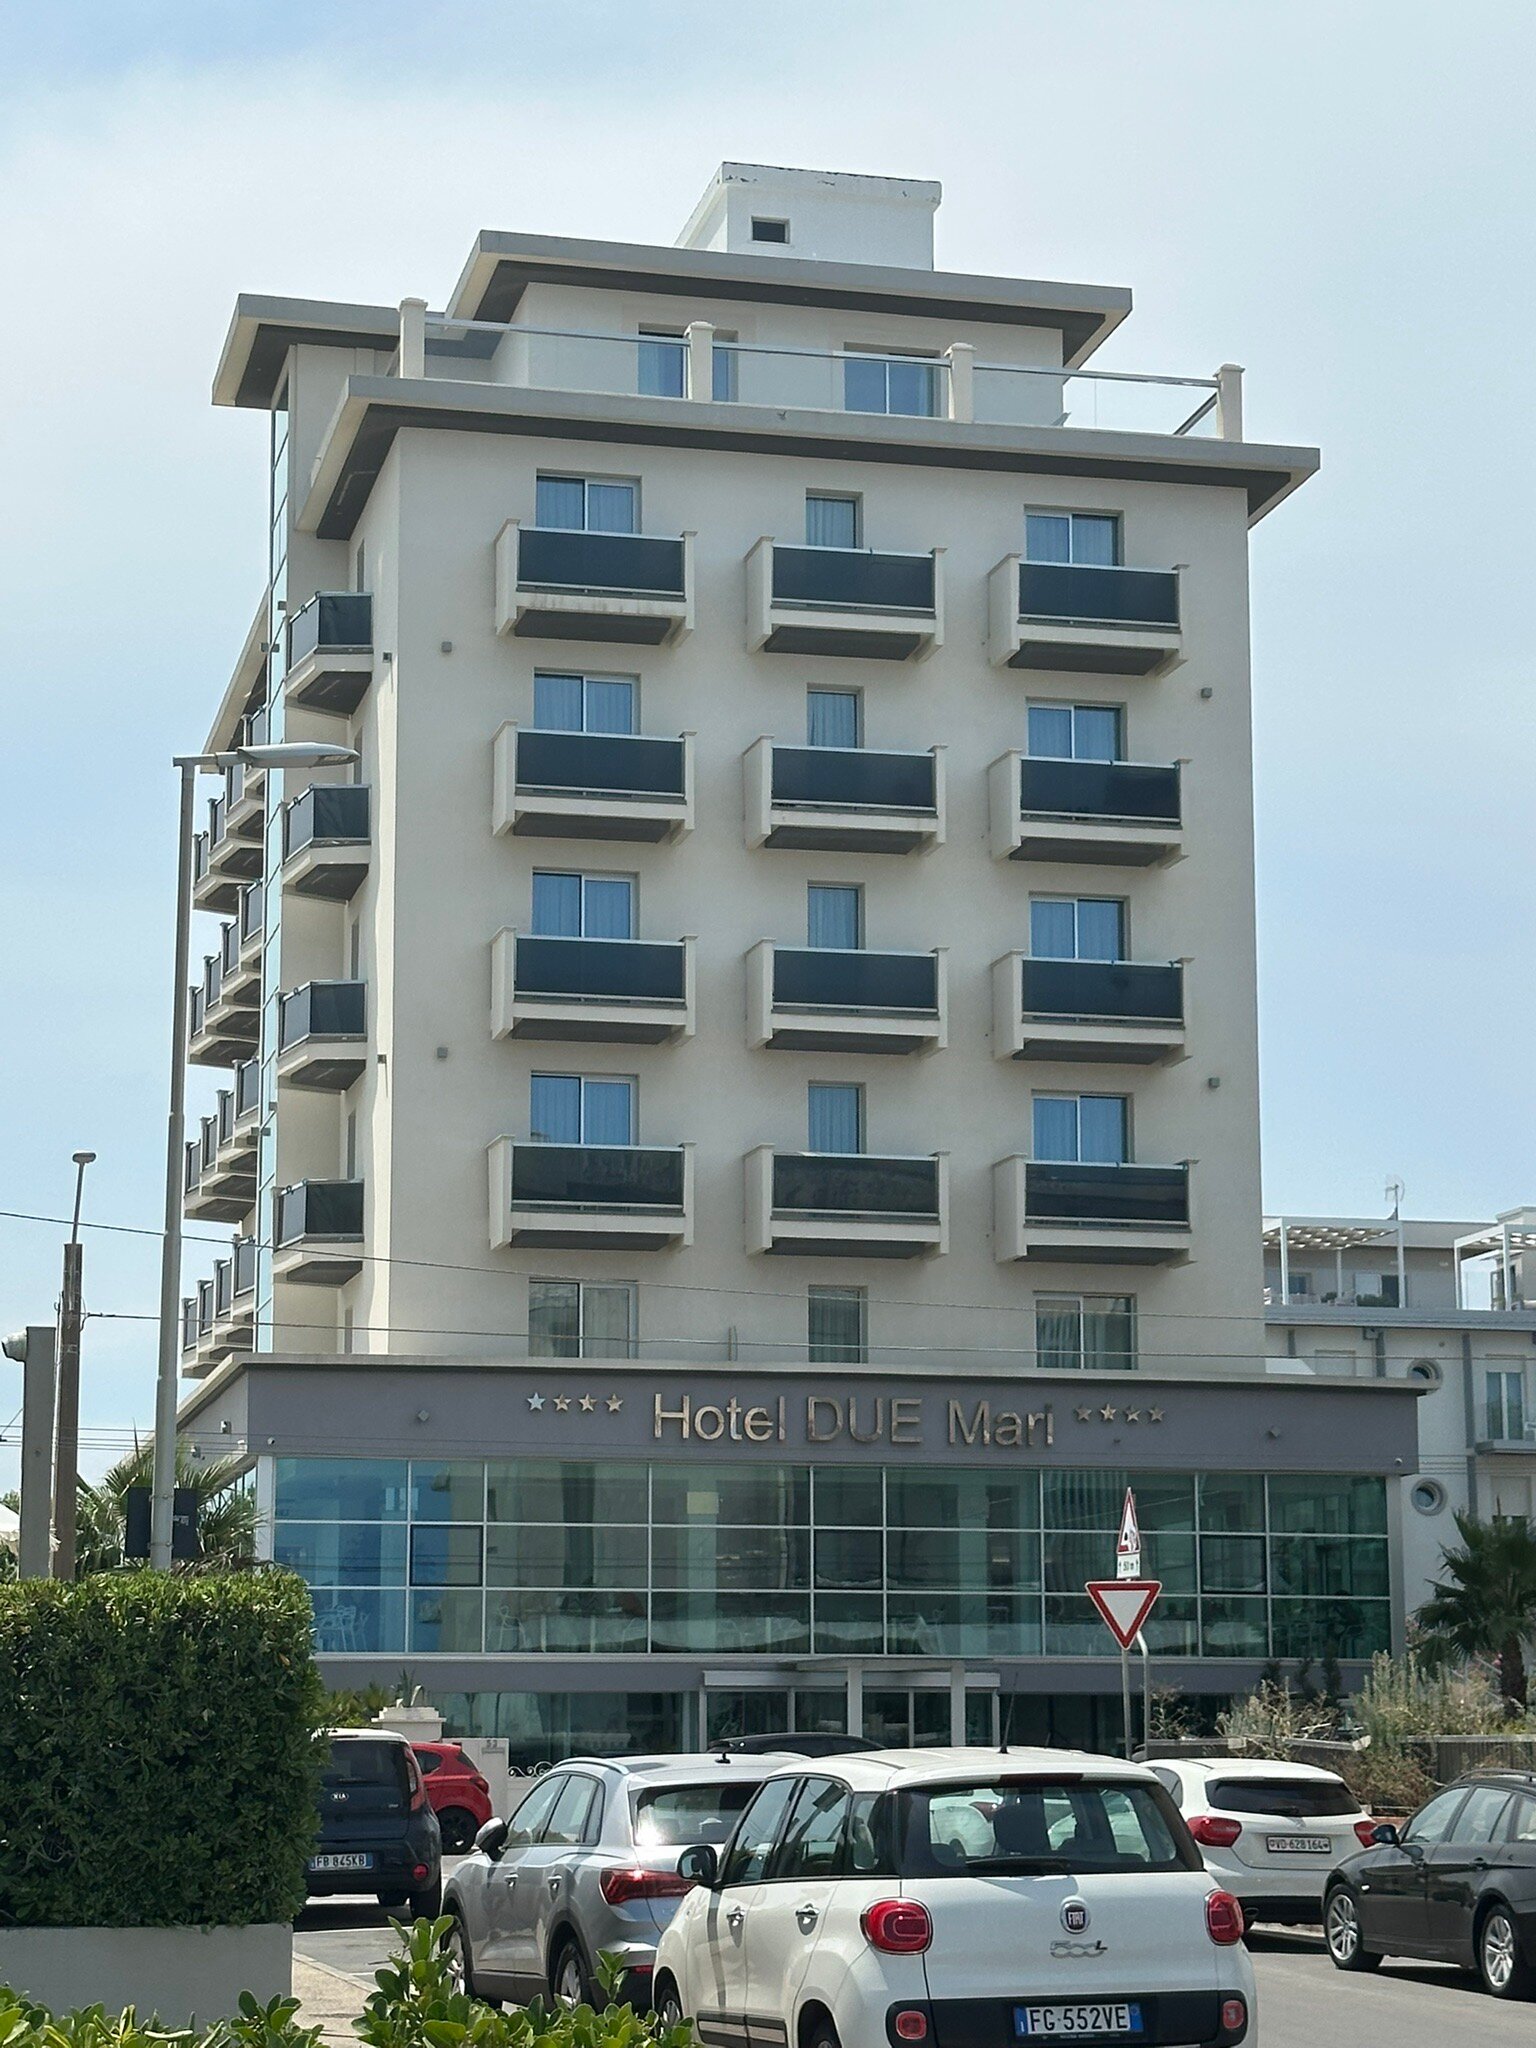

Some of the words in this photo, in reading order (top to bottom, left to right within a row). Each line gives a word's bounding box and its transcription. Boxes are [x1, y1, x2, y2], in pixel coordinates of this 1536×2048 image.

[654, 1393, 786, 1441] Hotel
[808, 1396, 923, 1443] DUE
[948, 1399, 1054, 1446] Mari
[1067, 1911, 1085, 1925] FIAT
